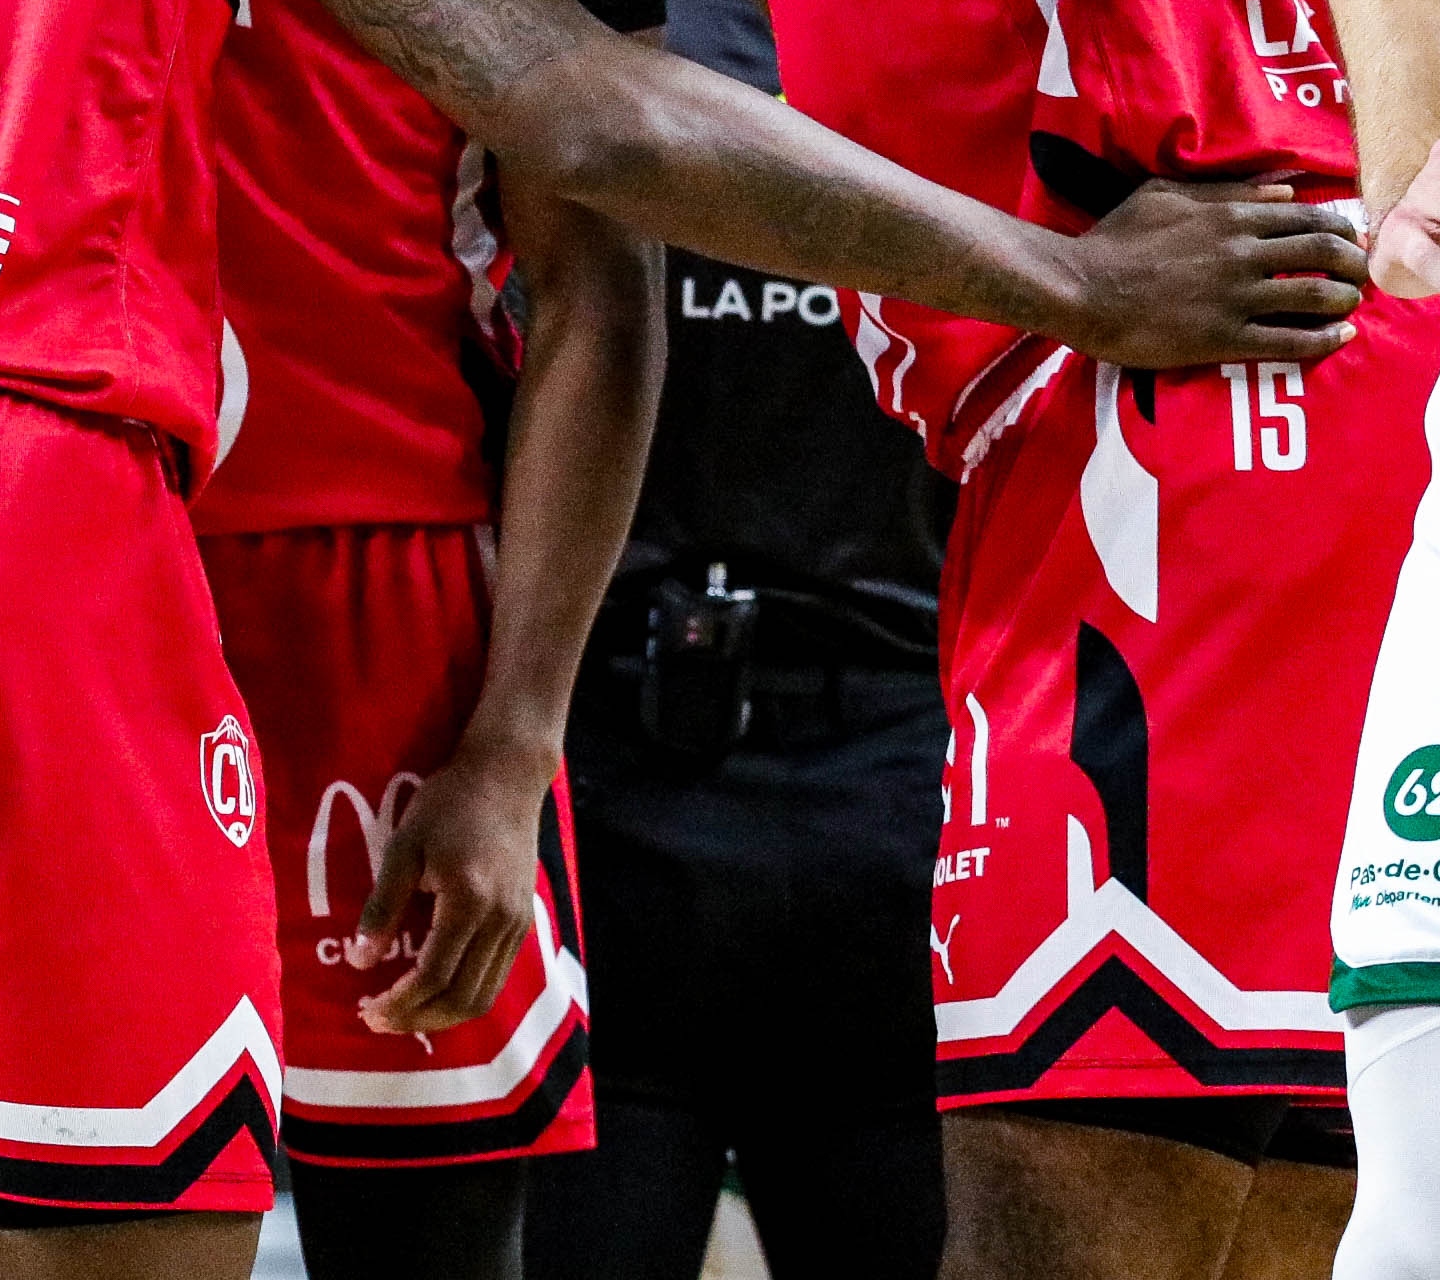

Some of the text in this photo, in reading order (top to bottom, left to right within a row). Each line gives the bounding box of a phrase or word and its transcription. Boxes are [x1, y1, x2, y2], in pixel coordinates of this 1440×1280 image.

[680, 278, 839, 327] LA PO
[1221, 361, 1307, 472] 15
[211, 743, 254, 817] CB
